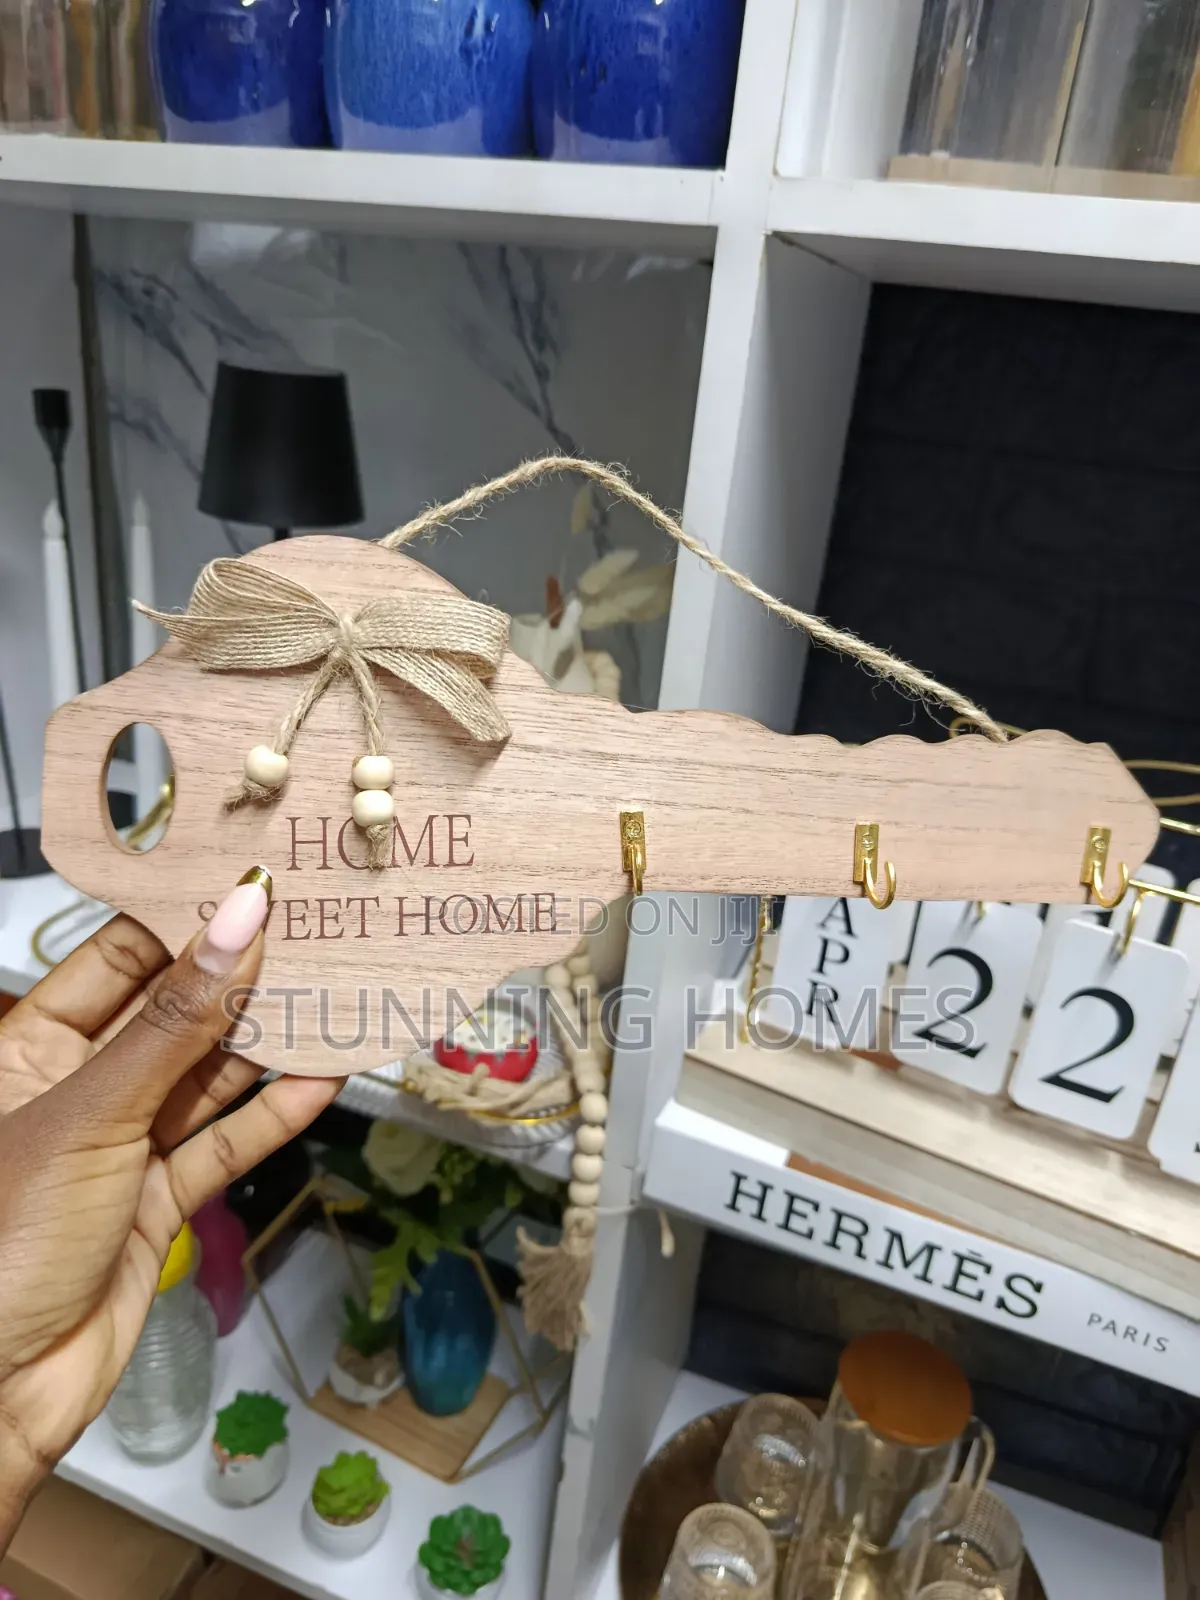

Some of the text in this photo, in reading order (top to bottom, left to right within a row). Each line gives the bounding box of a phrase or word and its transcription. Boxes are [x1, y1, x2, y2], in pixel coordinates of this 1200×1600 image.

[393, 892, 557, 937] HOME
[807, 897, 858, 1026] APR
[1087, 1312, 1170, 1352] PARIS
